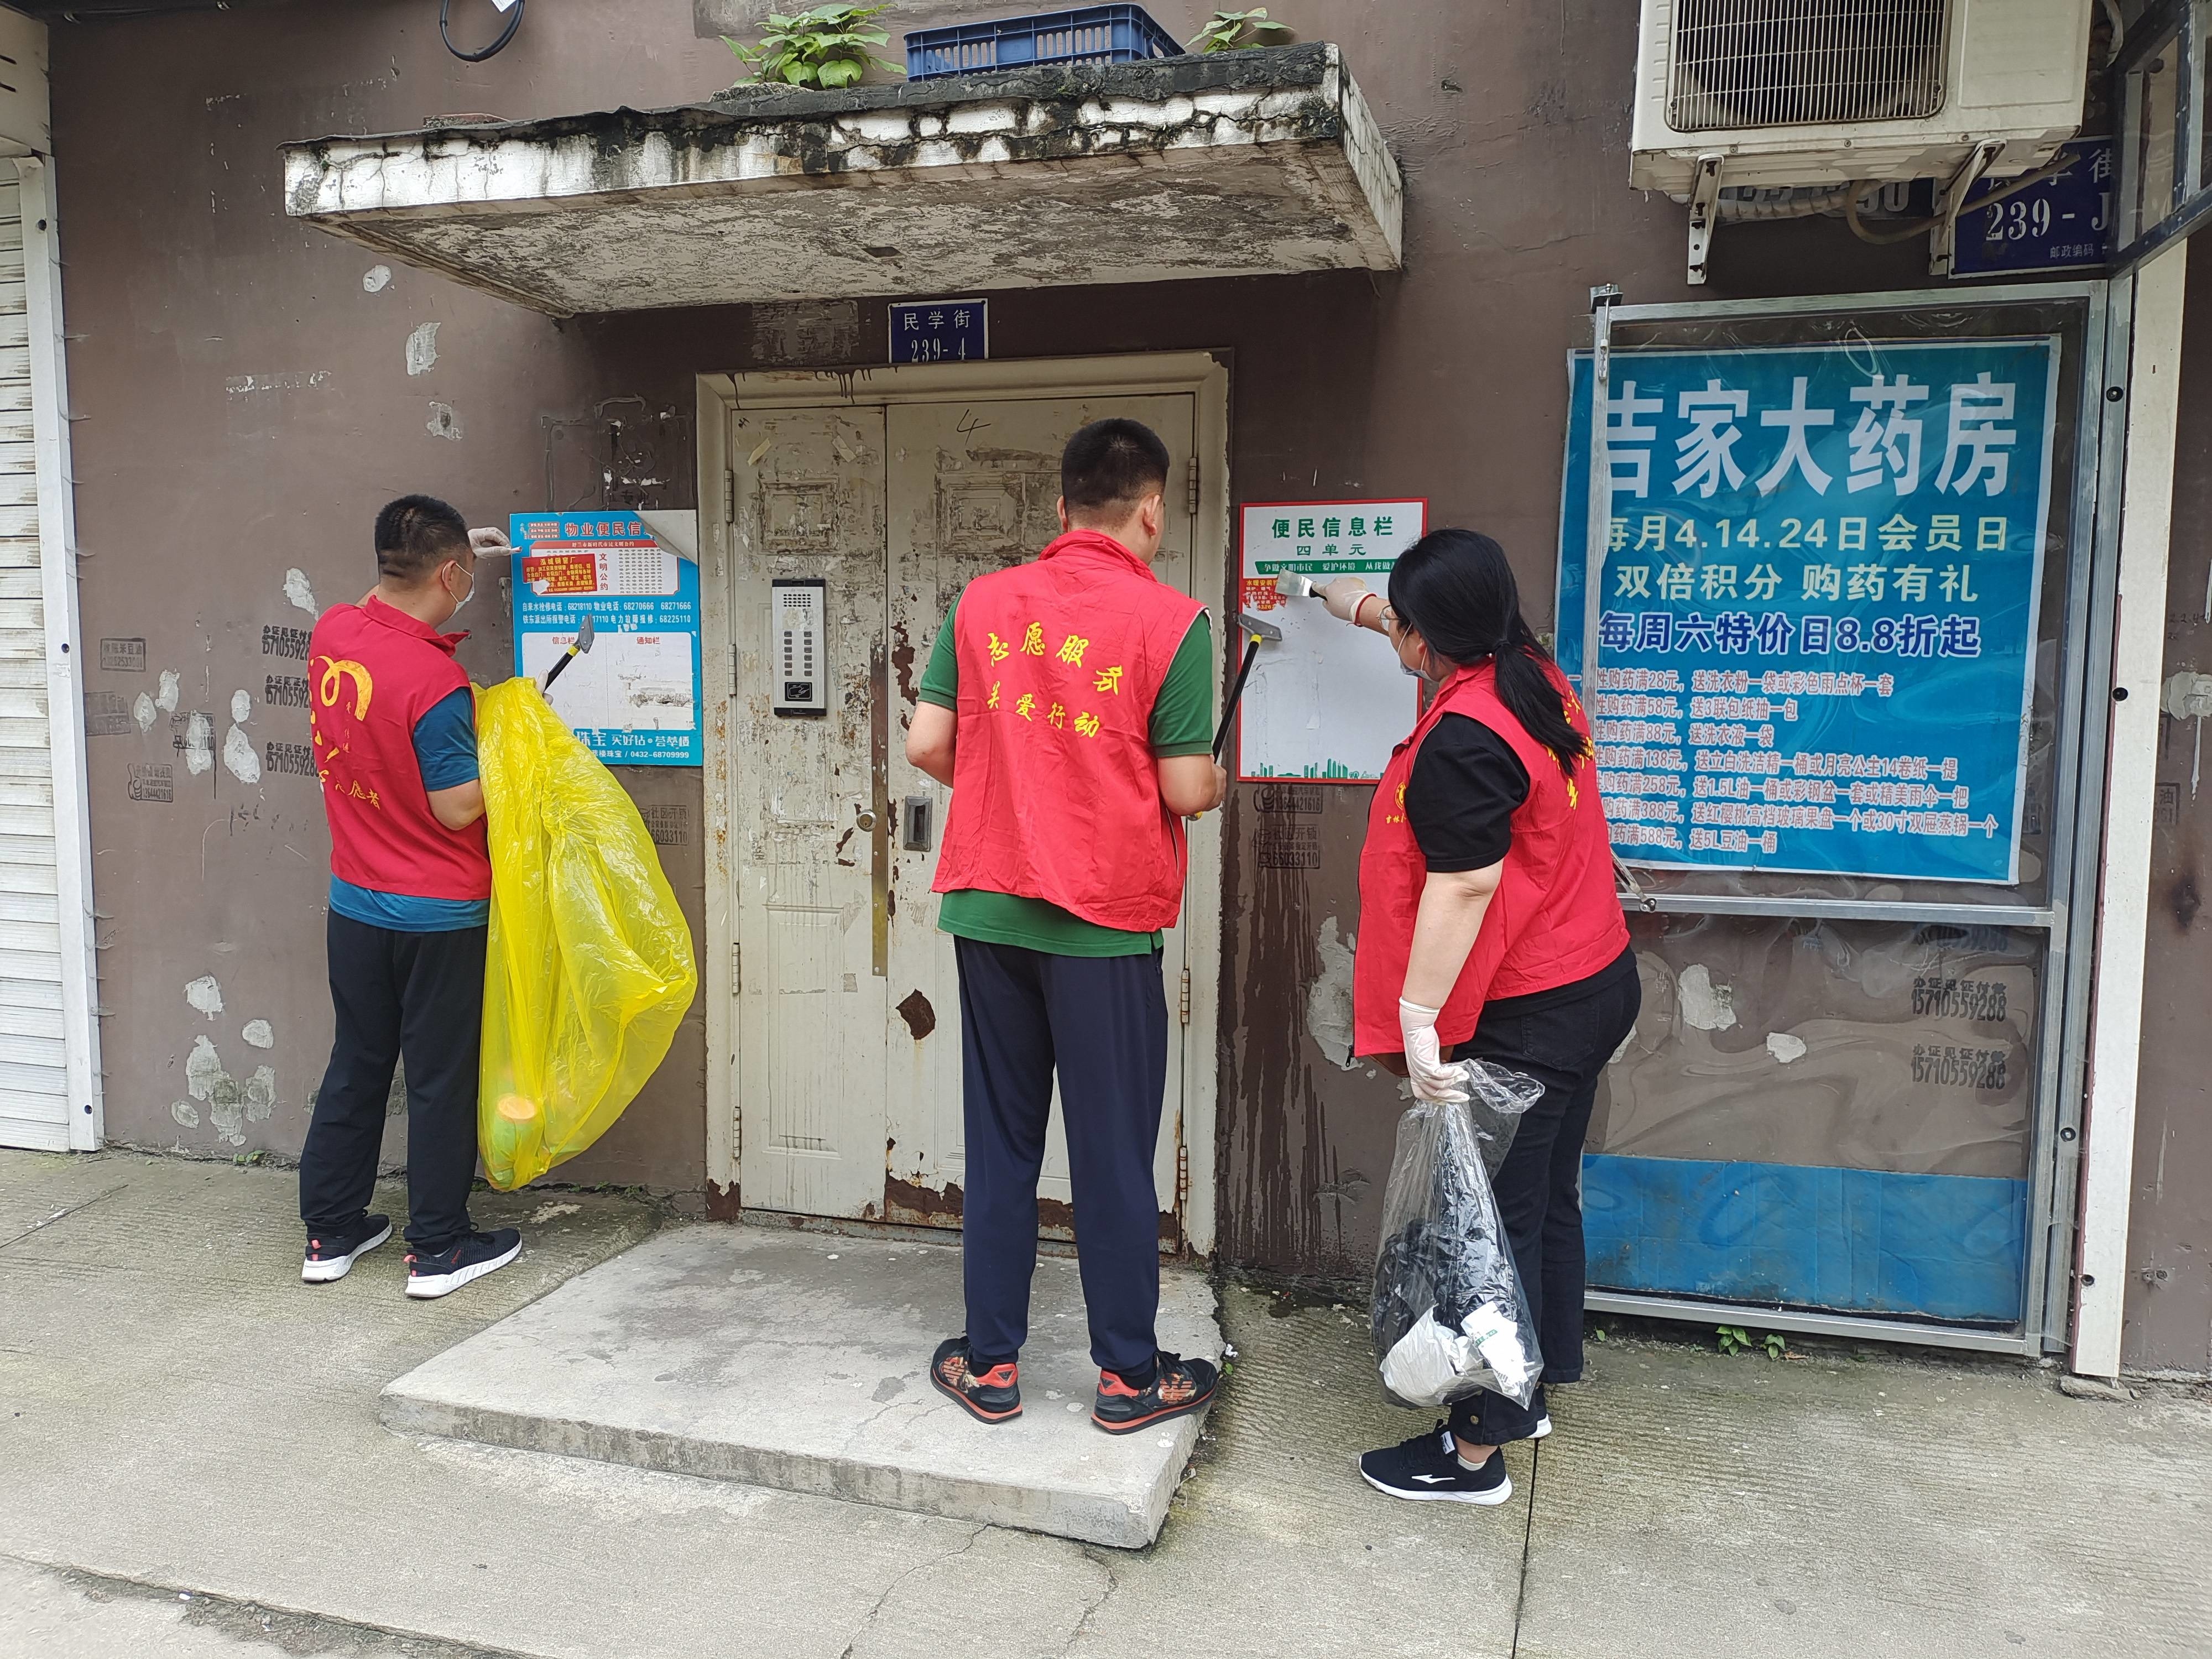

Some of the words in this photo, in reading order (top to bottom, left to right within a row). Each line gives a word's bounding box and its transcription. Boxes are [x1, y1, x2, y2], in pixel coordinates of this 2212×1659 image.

[2050, 243, 2094, 259] 邮政编码
[904, 310, 971, 331] 民学街
[1607, 372, 2016, 498] 吉家大药房
[565, 521, 648, 536] 物业便民信
[1272, 516, 1393, 539] 便民信息栏
[1609, 514, 2007, 552] 每月4.14.24日会员日
[1297, 544, 1366, 556] 四单元
[598, 552, 608, 591] 文明公约
[1365, 561, 1395, 571] 从我做
[1614, 562, 1782, 601] 双倍积分
[1801, 564, 1978, 602] 购药有礼
[661, 601, 691, 610] 68271666
[552, 637, 575, 645] 信息栏
[637, 636, 660, 645] 通知栏
[1599, 611, 1981, 657] 每周六特价日8.8折起
[630, 750, 690, 759] 0432-68709999
[1911, 989, 2007, 1021] 15710559288
[1911, 1057, 2006, 1089] 15710559288
